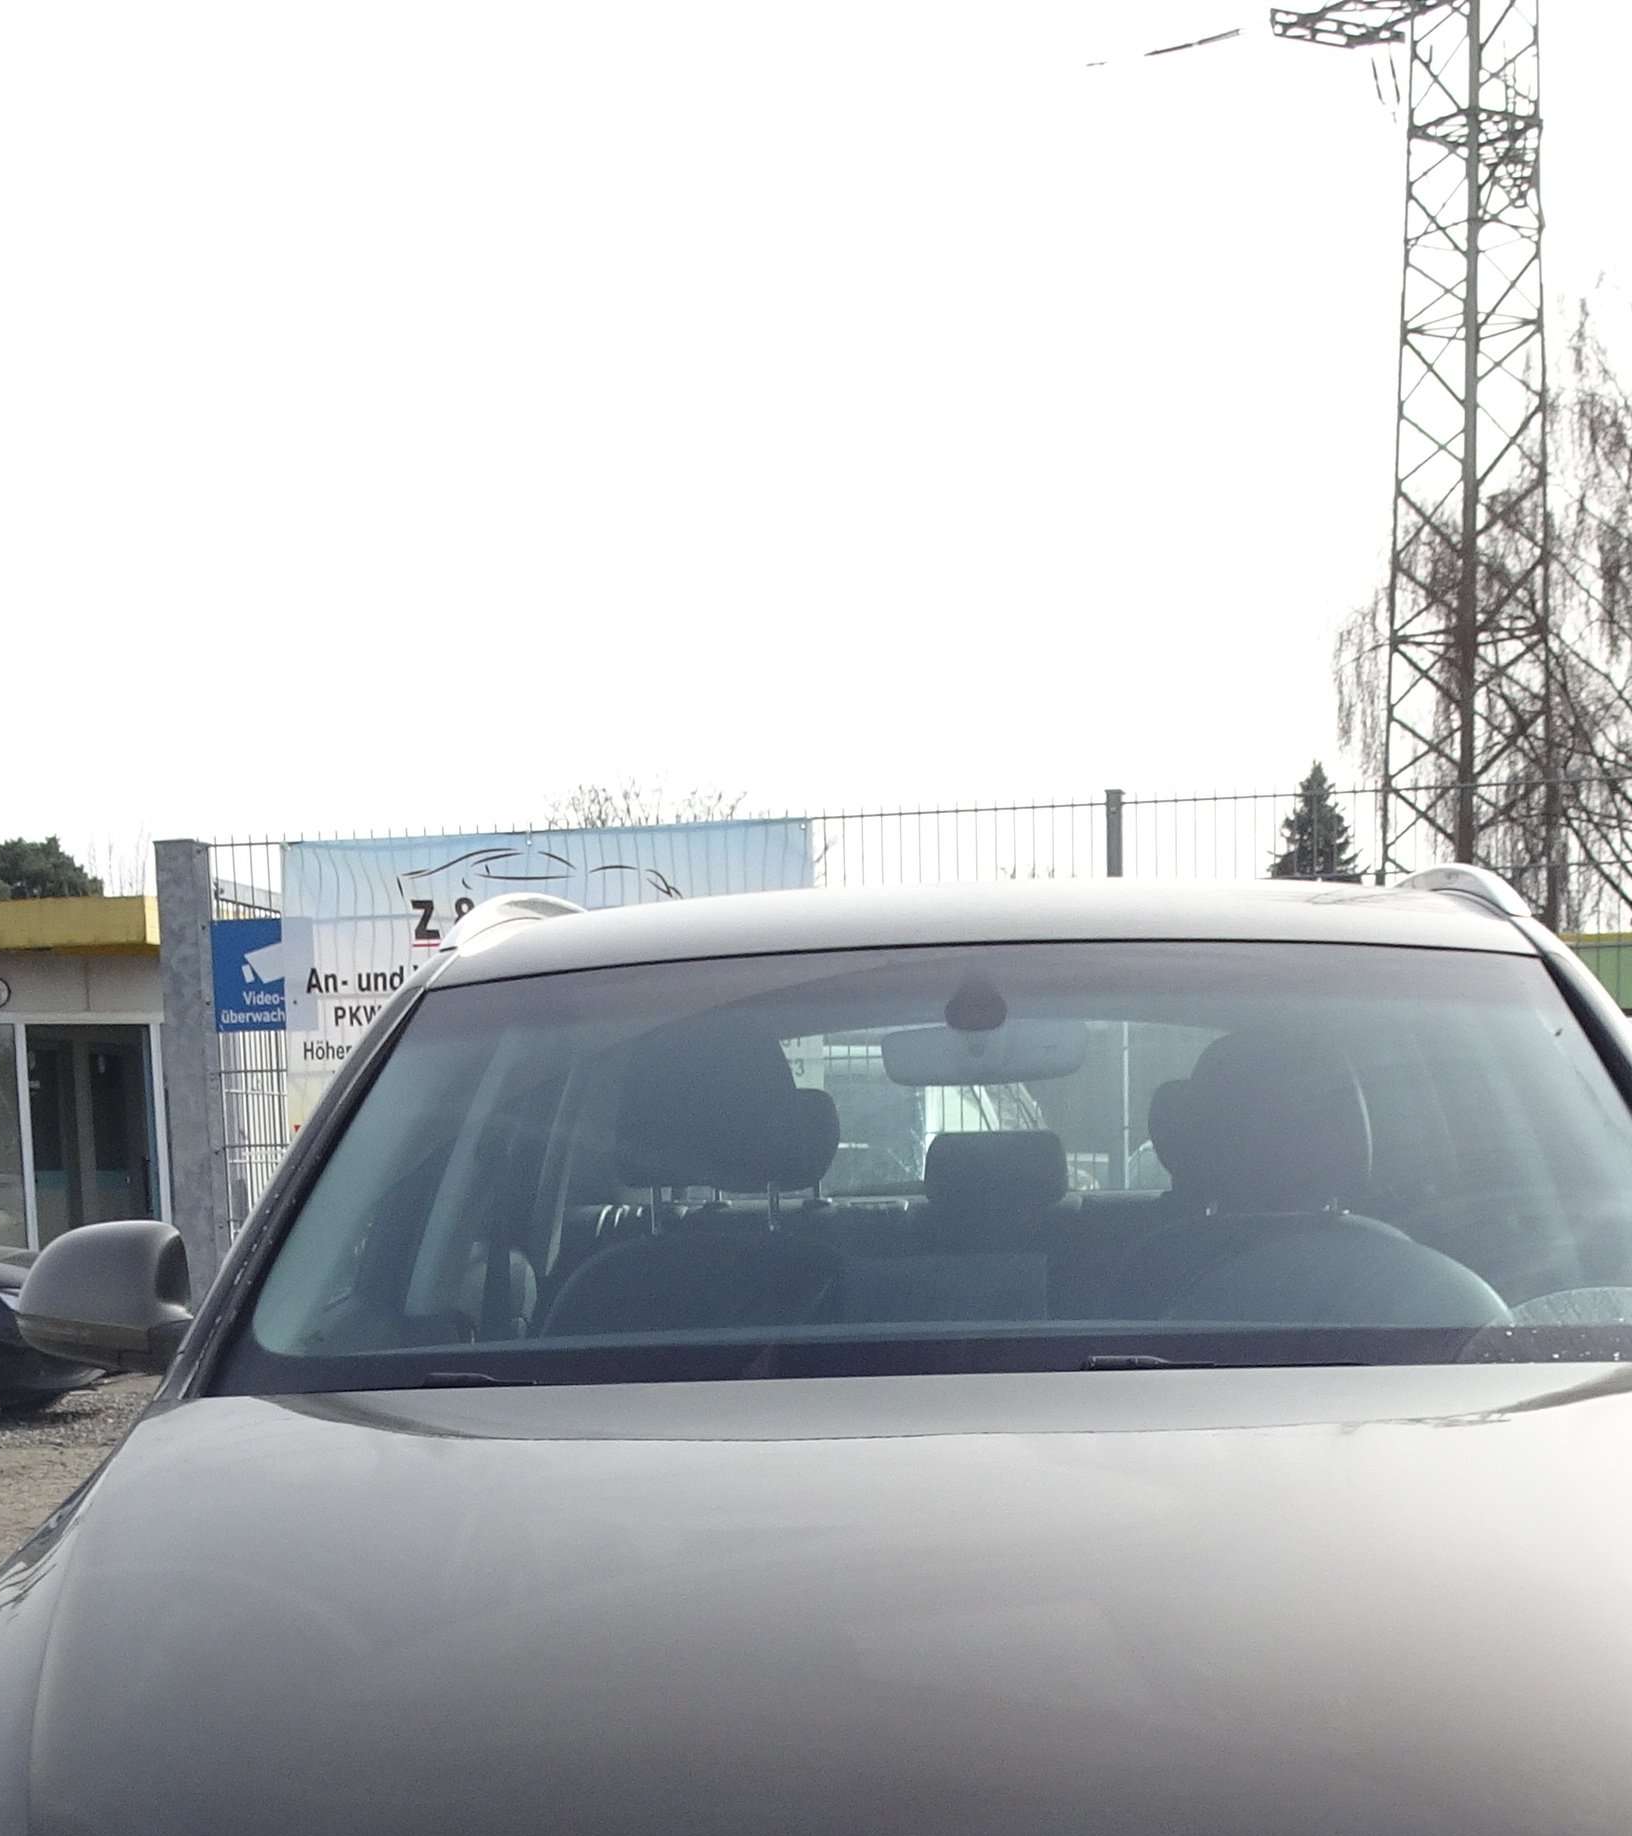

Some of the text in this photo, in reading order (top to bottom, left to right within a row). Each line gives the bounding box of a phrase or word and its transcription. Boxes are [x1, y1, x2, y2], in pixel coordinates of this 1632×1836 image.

[411, 899, 441, 940] Z
[306, 964, 404, 993] An- und
[242, 991, 285, 1006] Video-
